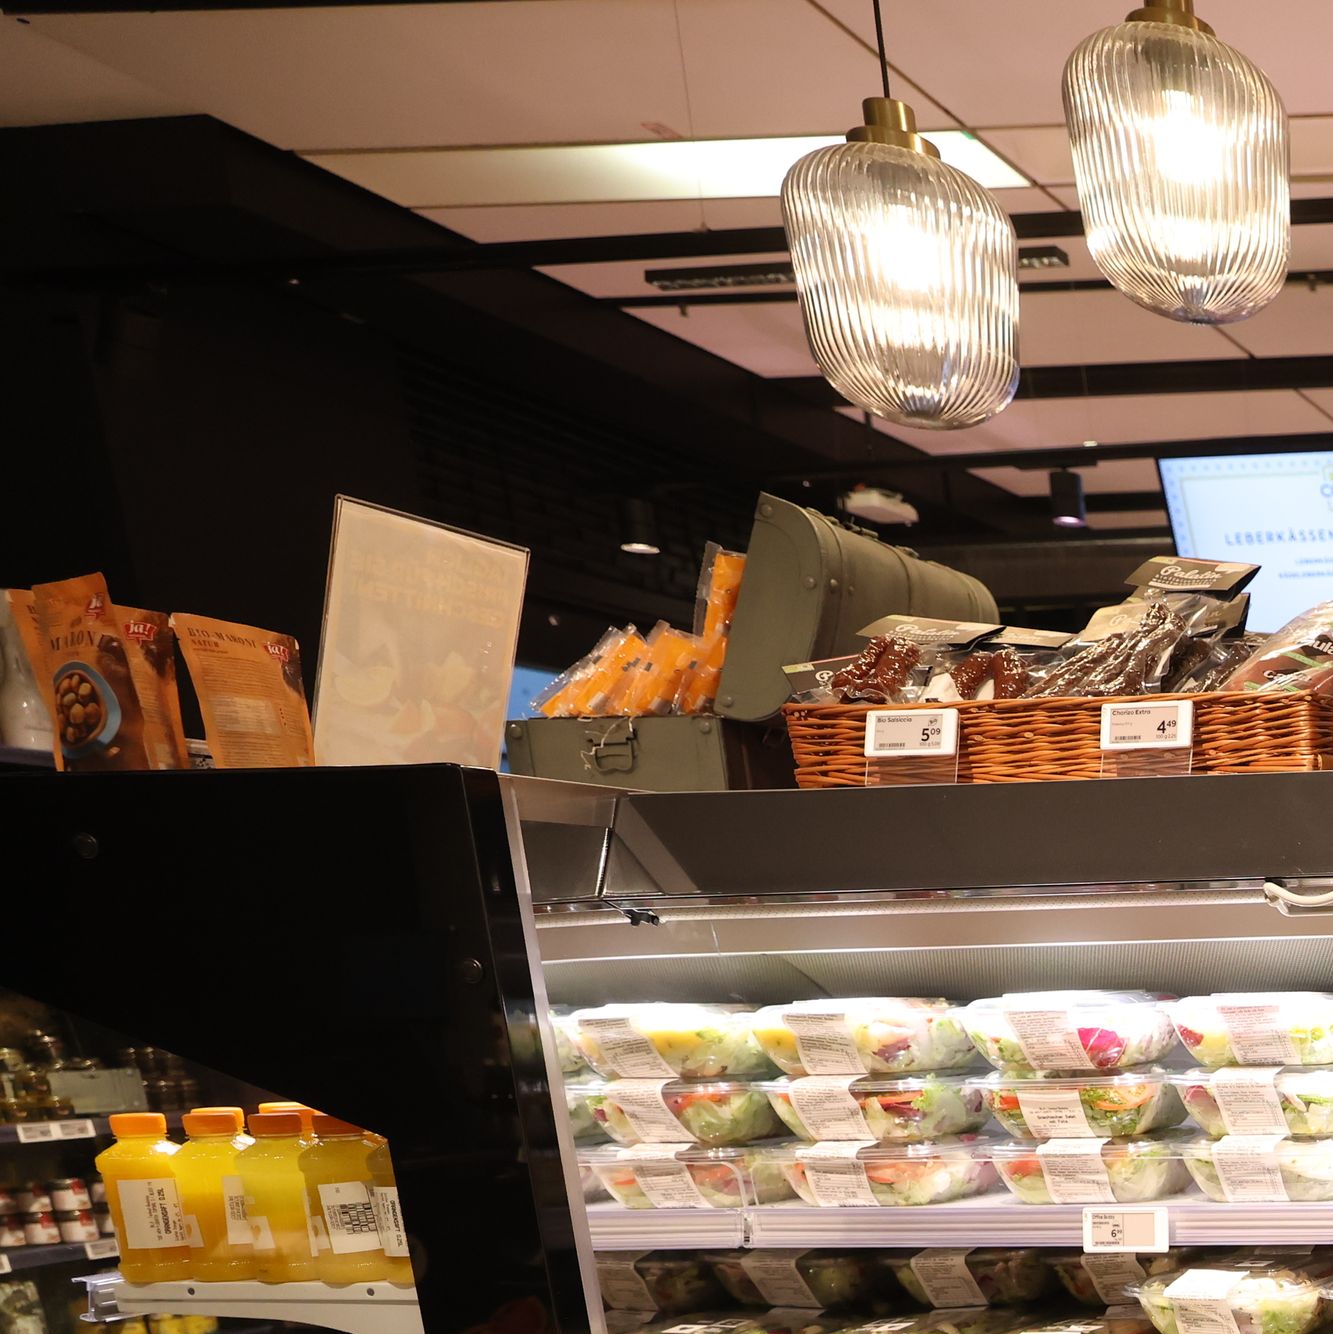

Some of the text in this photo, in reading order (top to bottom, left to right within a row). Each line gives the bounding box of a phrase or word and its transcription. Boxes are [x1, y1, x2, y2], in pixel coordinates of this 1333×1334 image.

[1160, 564, 1222, 580] Palatin
[130, 619, 150, 634] ja!
[1135, 708, 1150, 716] Extra
